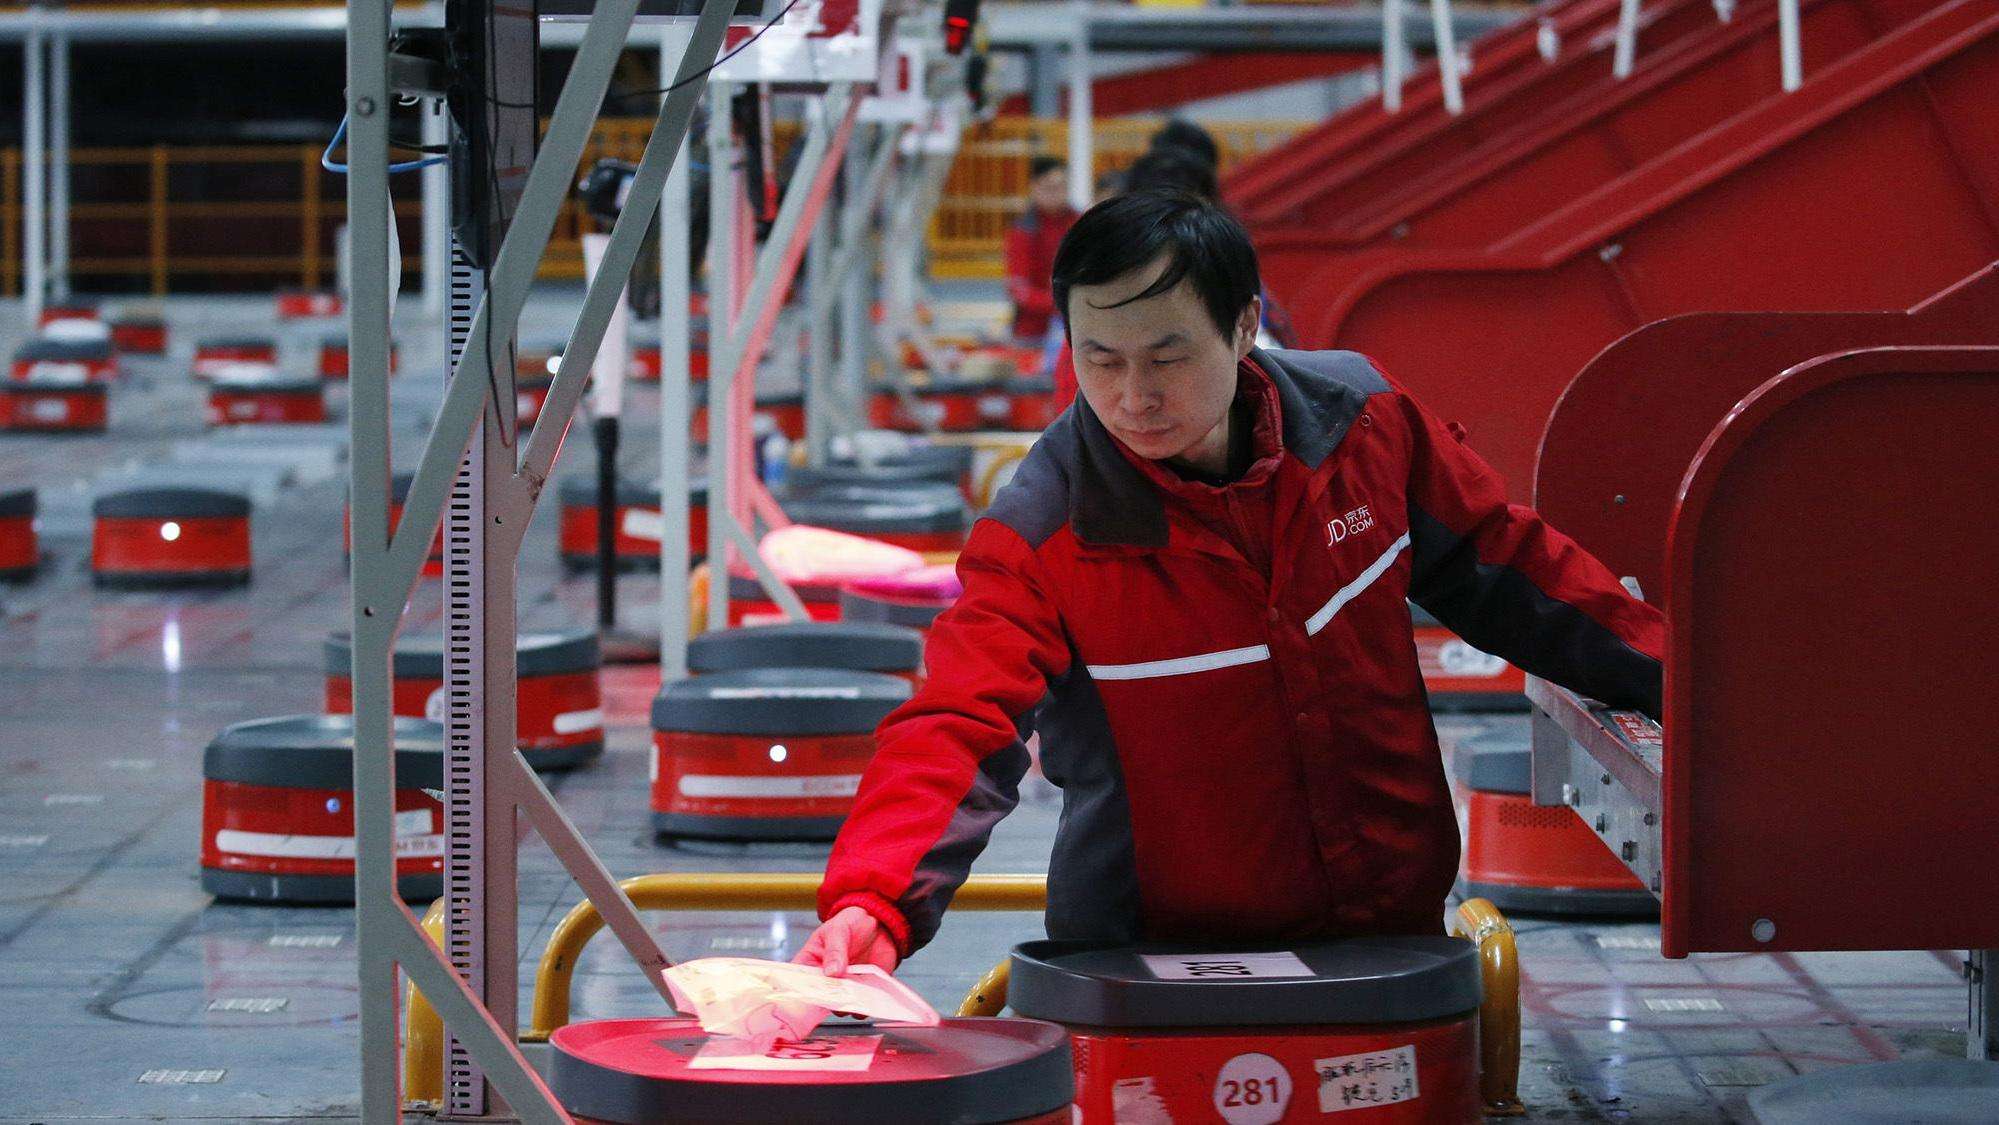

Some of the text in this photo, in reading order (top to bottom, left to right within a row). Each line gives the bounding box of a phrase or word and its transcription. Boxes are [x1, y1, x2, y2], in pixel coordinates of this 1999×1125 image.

[1344, 504, 1370, 525] 京东
[1327, 518, 1347, 547] JD
[1180, 961, 1252, 977] 281
[1223, 1077, 1279, 1107] 281
